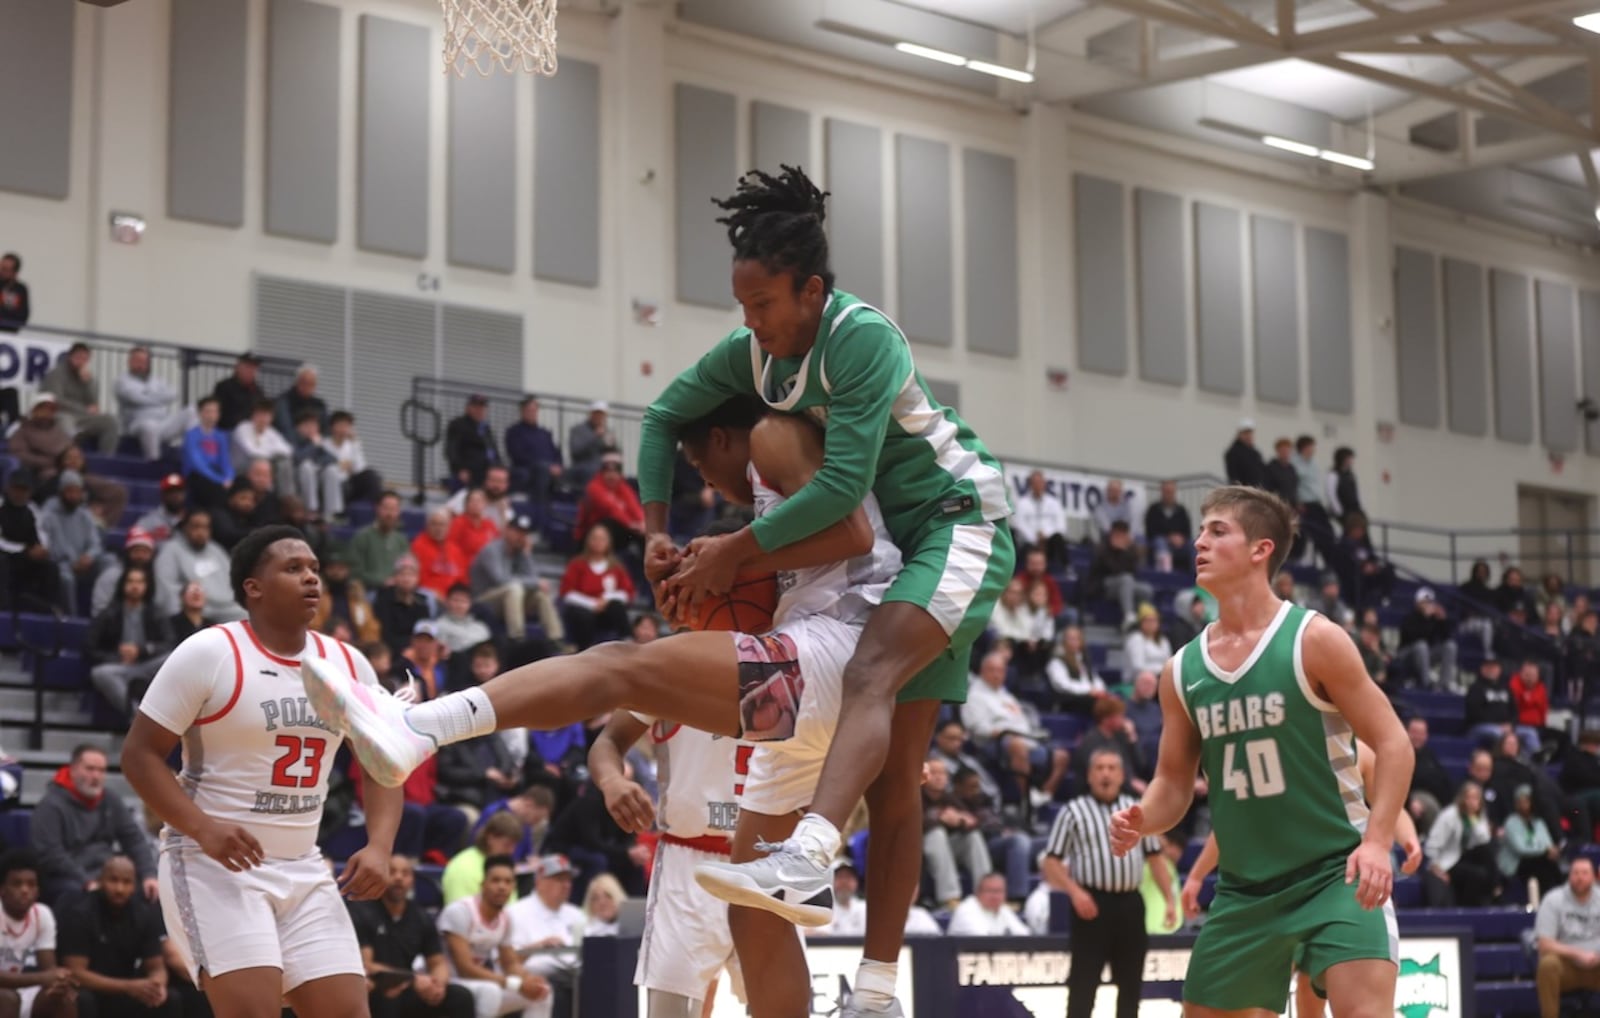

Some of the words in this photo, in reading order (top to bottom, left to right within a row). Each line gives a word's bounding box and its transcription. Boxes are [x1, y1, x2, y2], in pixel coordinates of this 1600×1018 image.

[0, 343, 69, 383] OR
[260, 697, 340, 737] POL
[1195, 692, 1285, 740] BEARS
[271, 734, 327, 788] 23
[1222, 737, 1286, 801] 40
